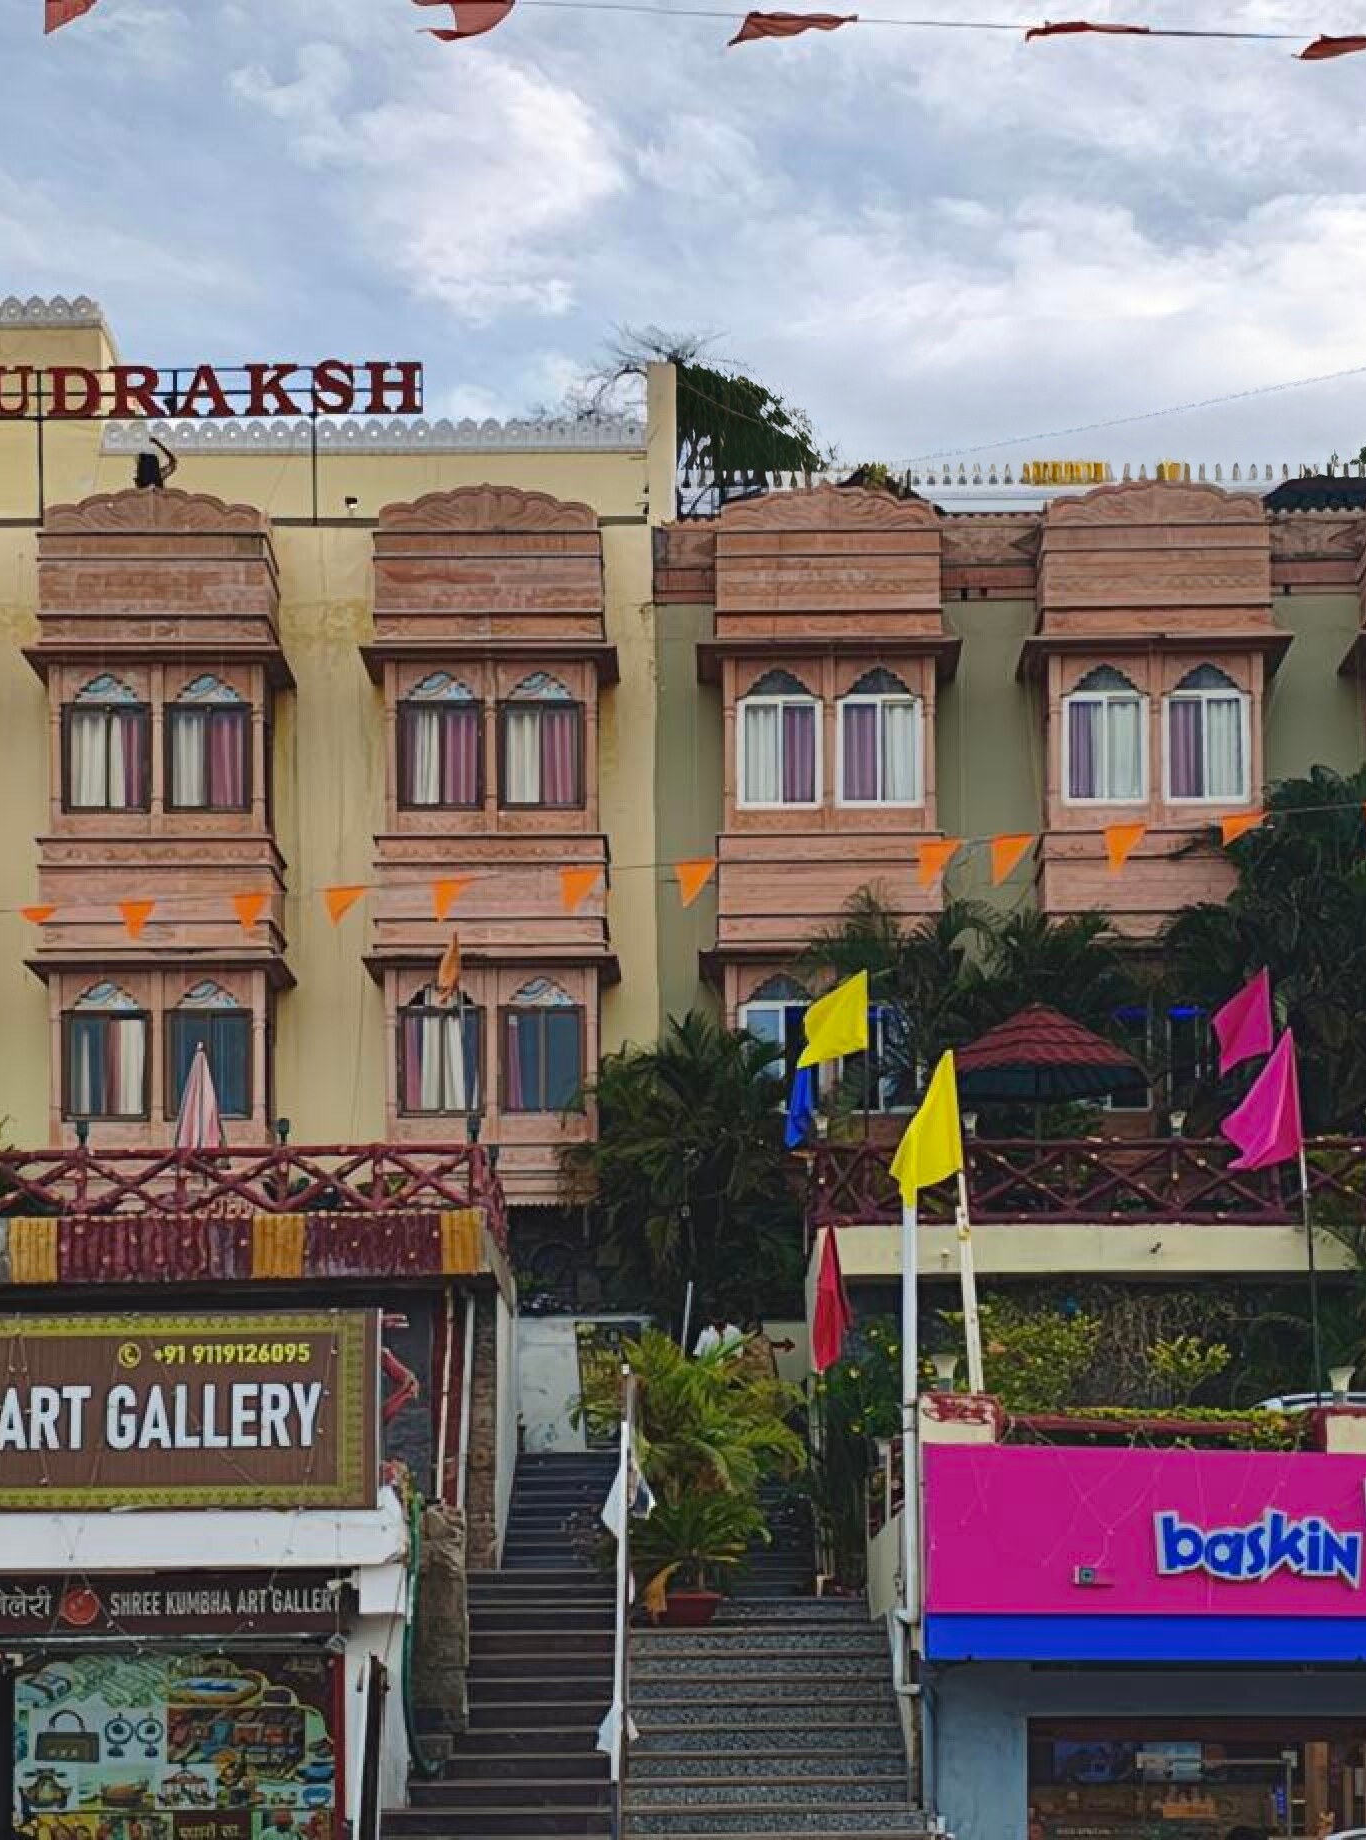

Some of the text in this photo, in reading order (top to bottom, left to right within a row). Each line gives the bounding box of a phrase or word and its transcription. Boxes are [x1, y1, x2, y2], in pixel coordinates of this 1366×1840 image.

[154, 1343, 311, 1364] +91 9119126095
[106, 1382, 322, 1450] GALLERY
[1154, 1509, 1363, 1588] baskin
[110, 1588, 341, 1617] SHREE KUMBHA ART GALLERY
